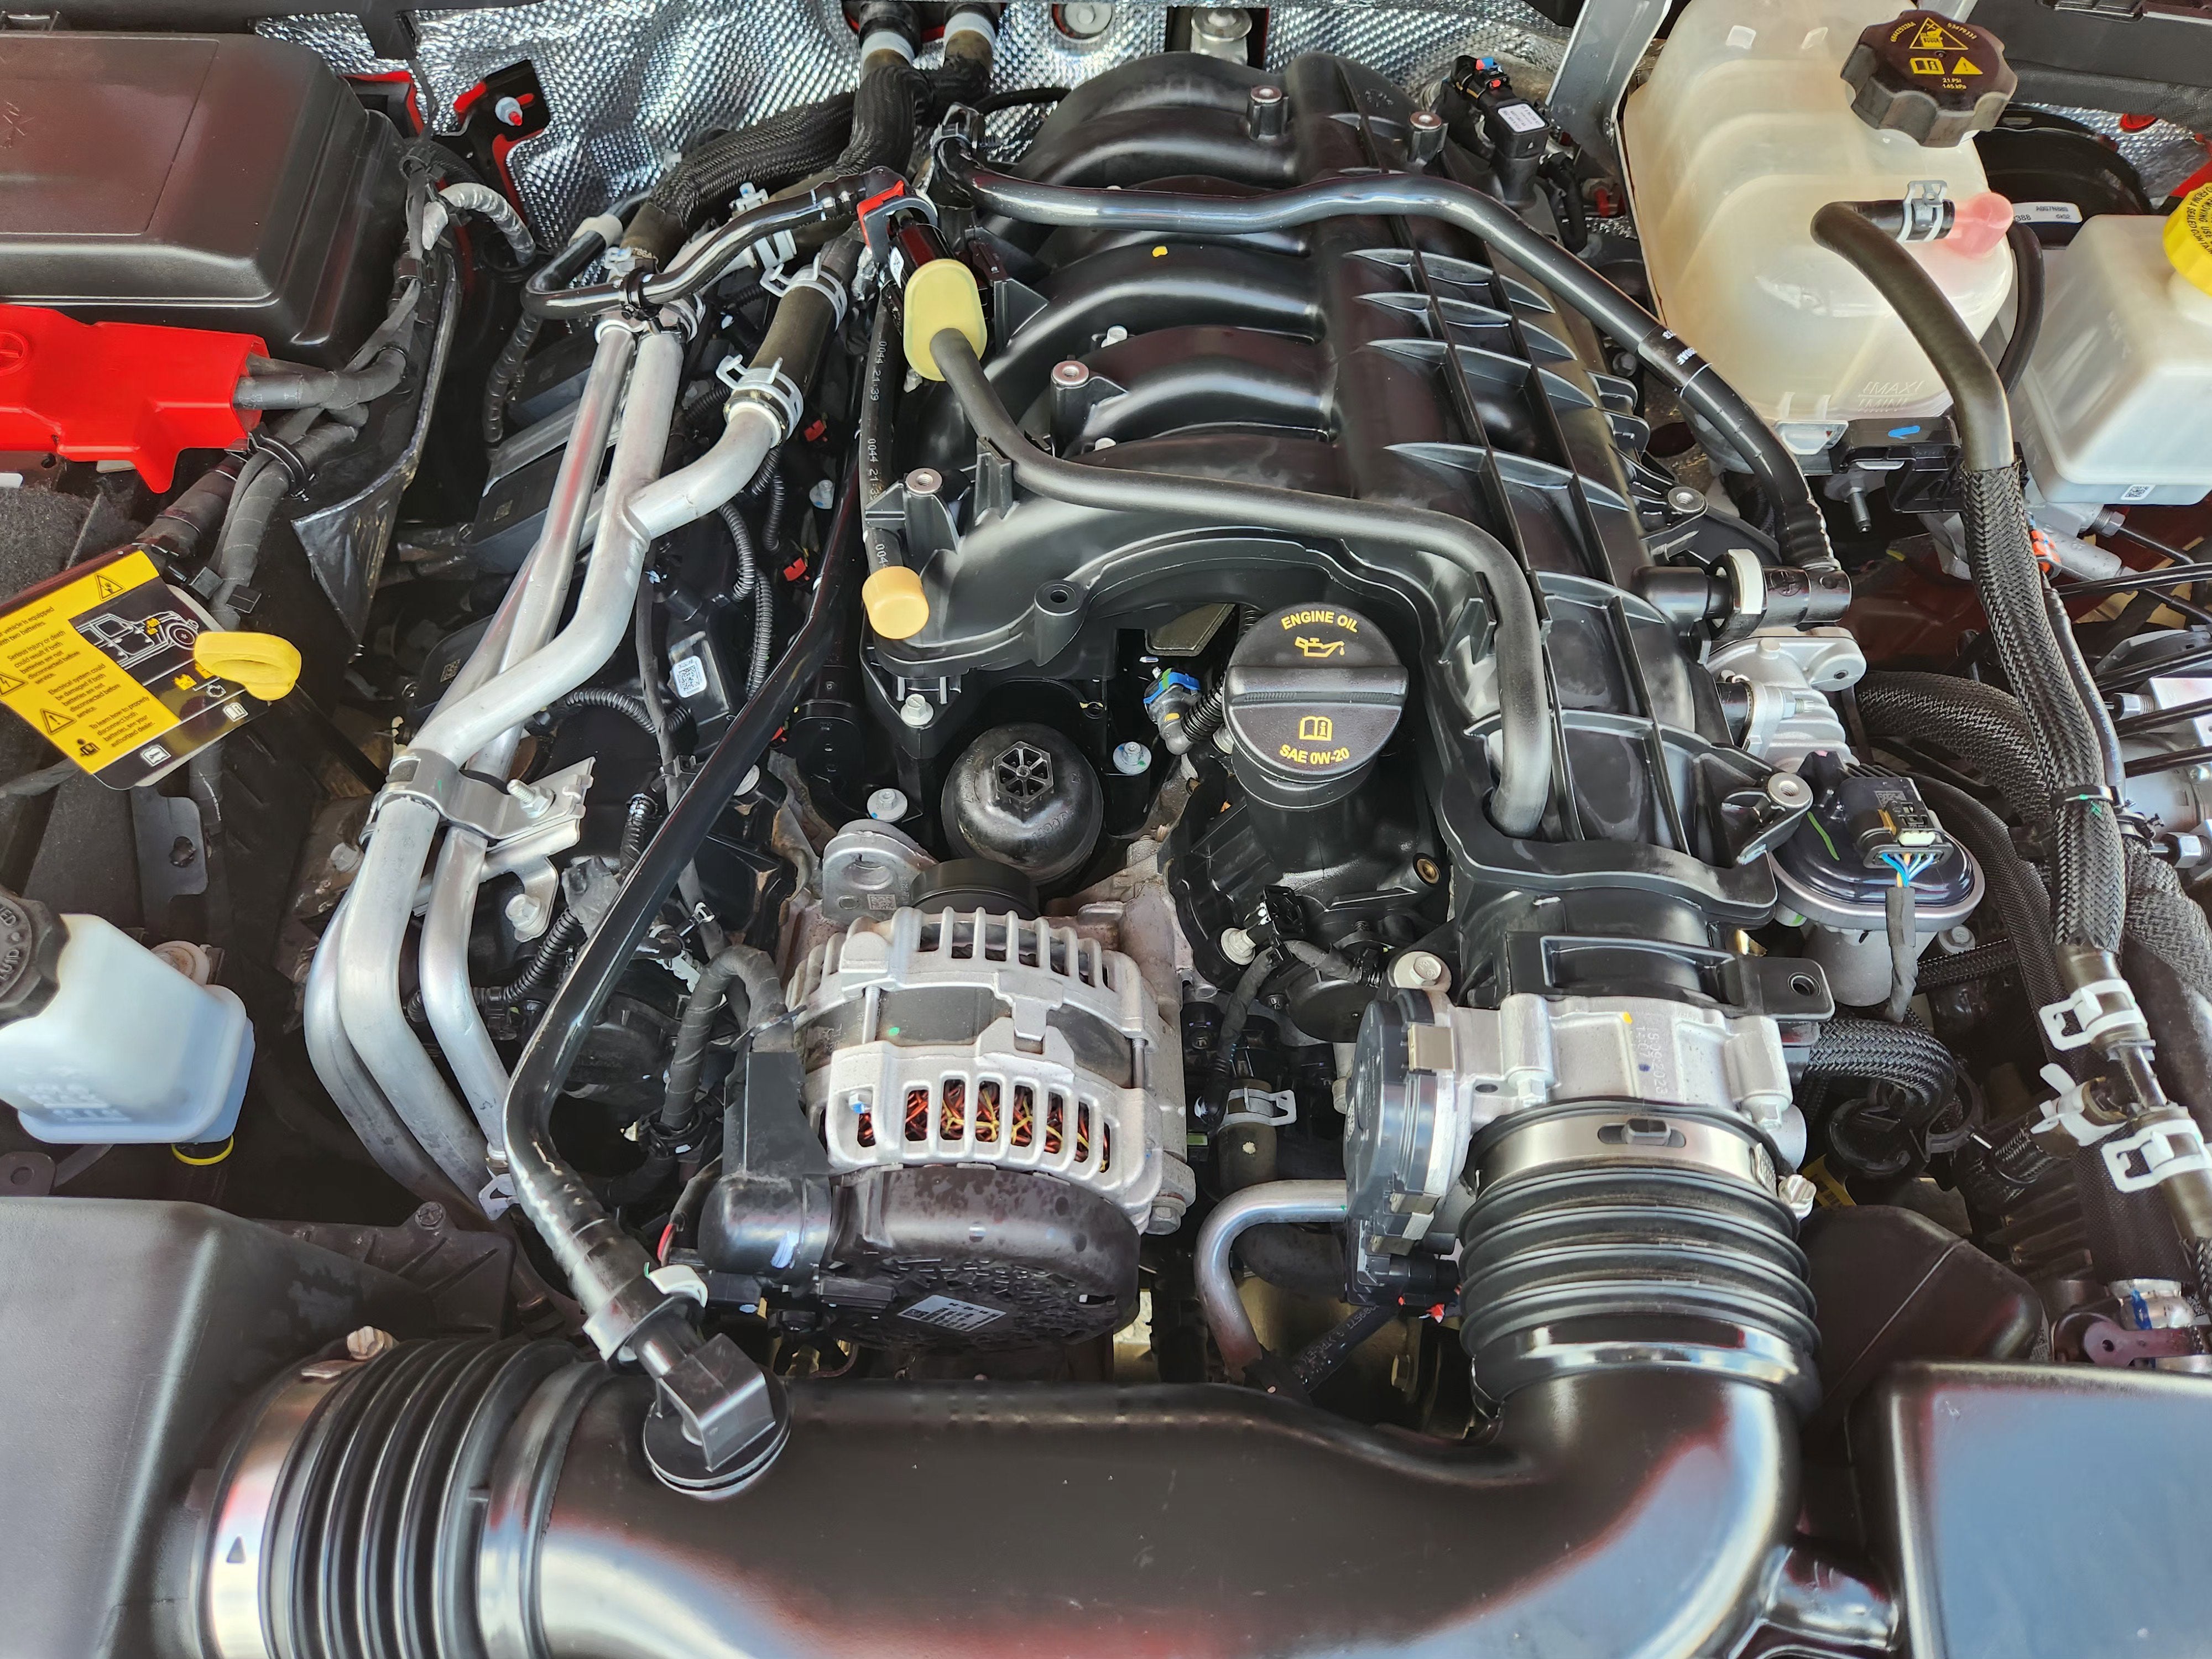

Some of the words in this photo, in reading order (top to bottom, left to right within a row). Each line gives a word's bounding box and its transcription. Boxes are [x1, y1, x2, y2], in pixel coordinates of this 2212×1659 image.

[1281, 611, 1335, 630] ENGINE
[1337, 614, 1358, 633] OIL
[7, 649, 28, 661] Serious
[28, 641, 44, 653] injury
[50, 630, 66, 640] death
[14, 657, 30, 668] could
[48, 641, 64, 651] both
[48, 680, 73, 695] Electrical
[72, 672, 92, 684] system
[90, 663, 106, 674] could
[64, 681, 88, 697] damaged
[92, 673, 106, 682] both
[61, 692, 87, 707] batteries
[70, 692, 105, 712] disconnected
[97, 716, 111, 726] learn
[109, 710, 123, 719] how
[1279, 744, 1308, 764] SAE
[1310, 747, 1349, 764] 0W-20
